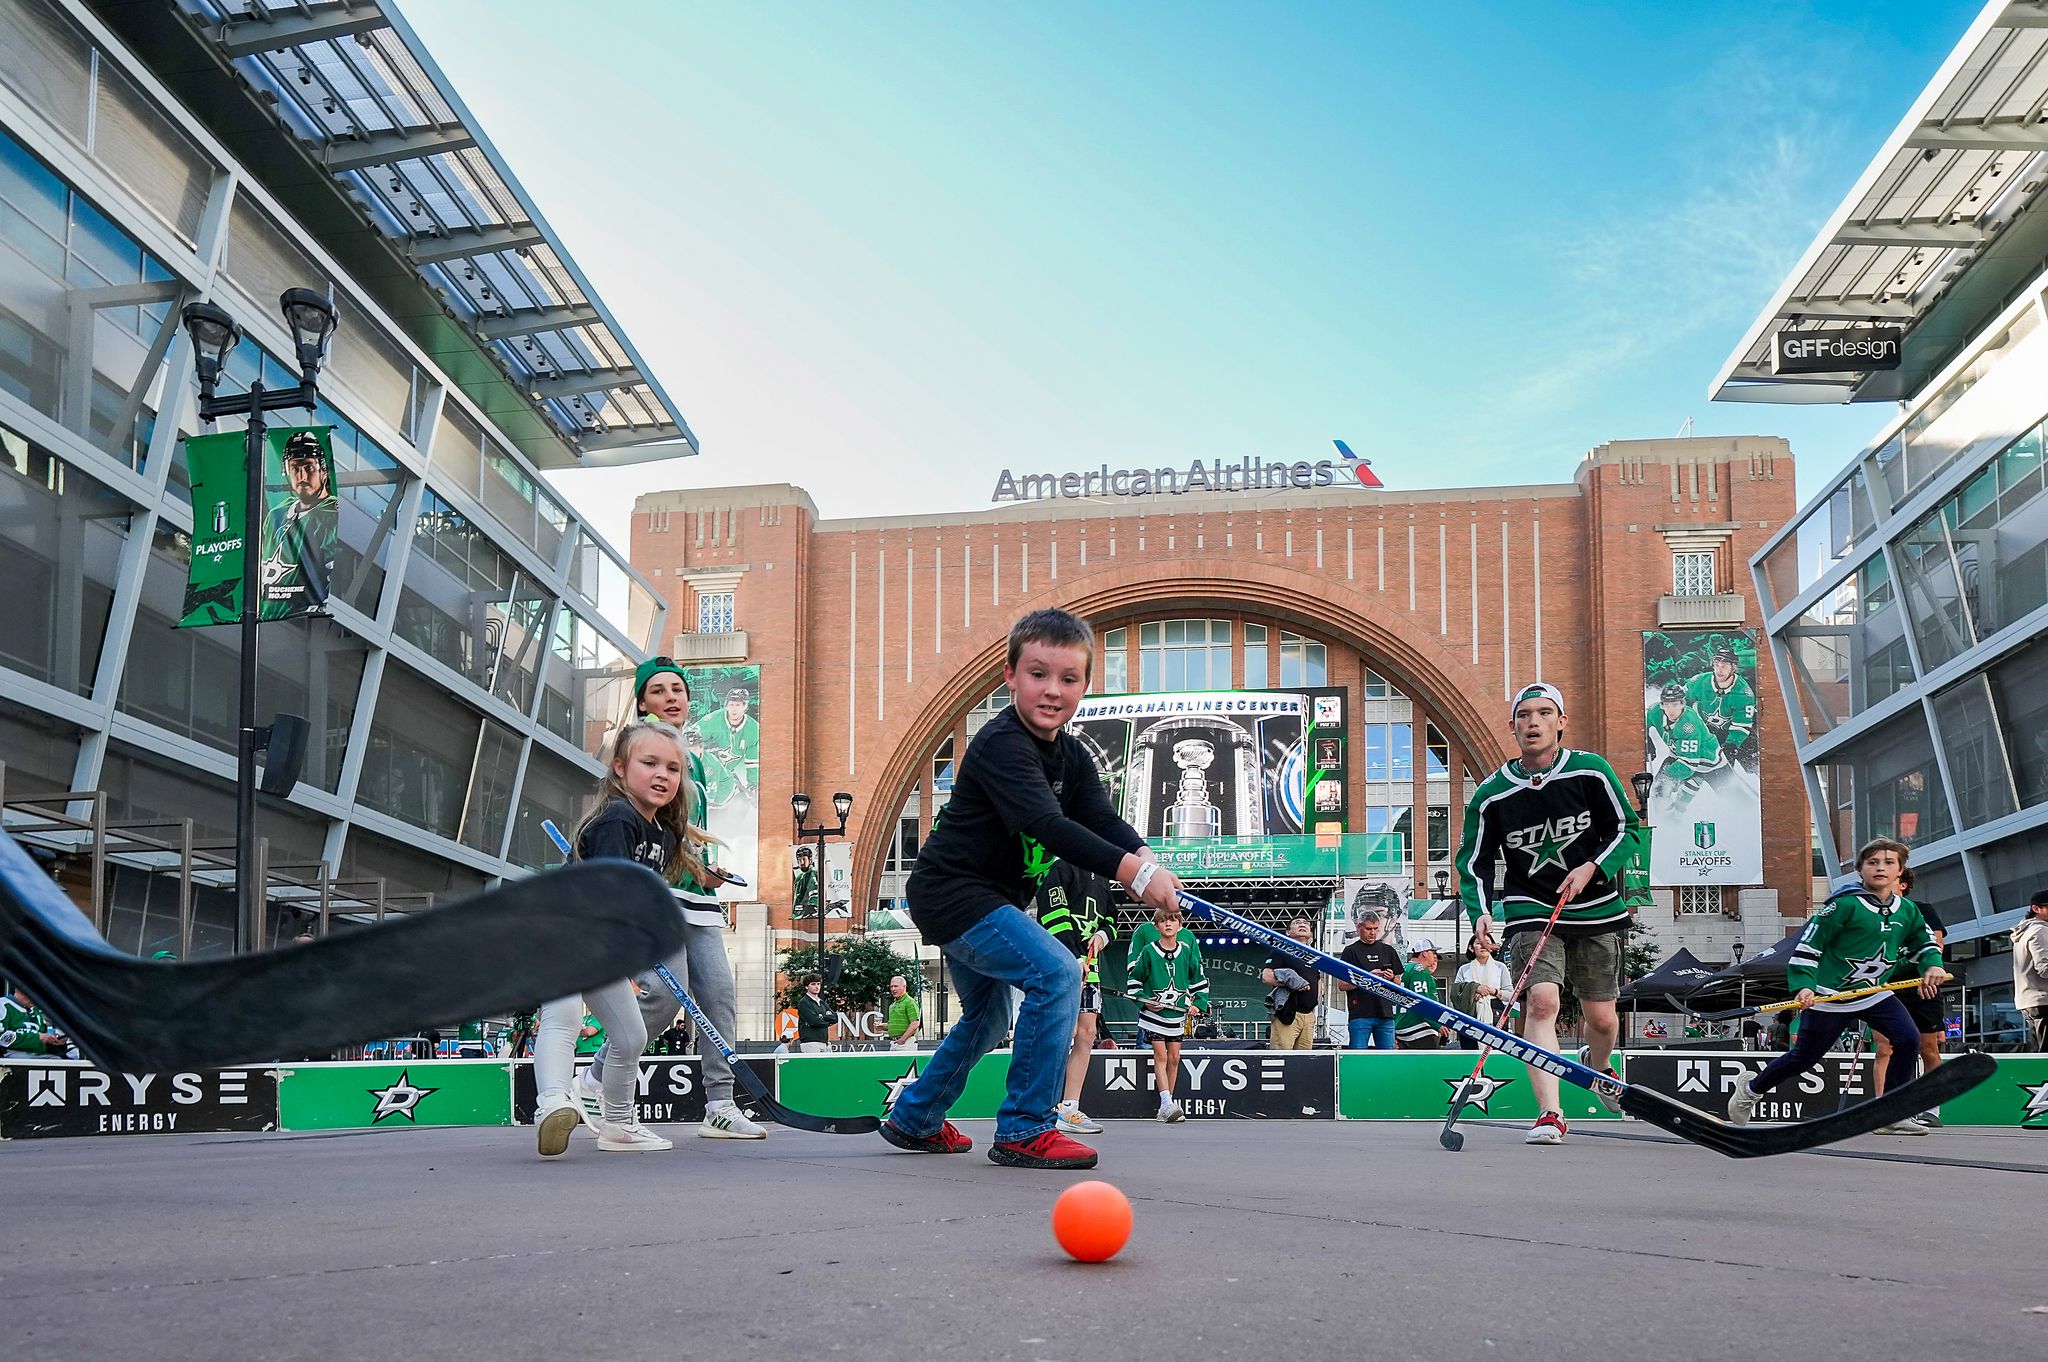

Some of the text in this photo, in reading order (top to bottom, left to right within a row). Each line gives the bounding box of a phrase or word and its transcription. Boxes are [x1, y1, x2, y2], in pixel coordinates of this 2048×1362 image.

[991, 455, 1335, 502] American Airlines
[195, 538, 242, 555] PLAYOFFS
[1681, 740, 1699, 753] 55
[1506, 809, 1592, 849] STARS
[1175, 852, 1198, 862] CUP
[1217, 851, 1273, 861] PLAYOFFS
[1679, 856, 1732, 866] PLAYOFFS
[1413, 980, 1428, 993] 24
[837, 1011, 886, 1039] NC
[1437, 1010, 1568, 1077] Franklin
[1147, 1058, 1285, 1092] YSE
[79, 1071, 248, 1107] RYSE
[635, 1103, 674, 1120] ERGY
[1174, 1098, 1227, 1116] NERGY
[1749, 1101, 1804, 1119] NERGY
[99, 1112, 178, 1132] ENERGY
